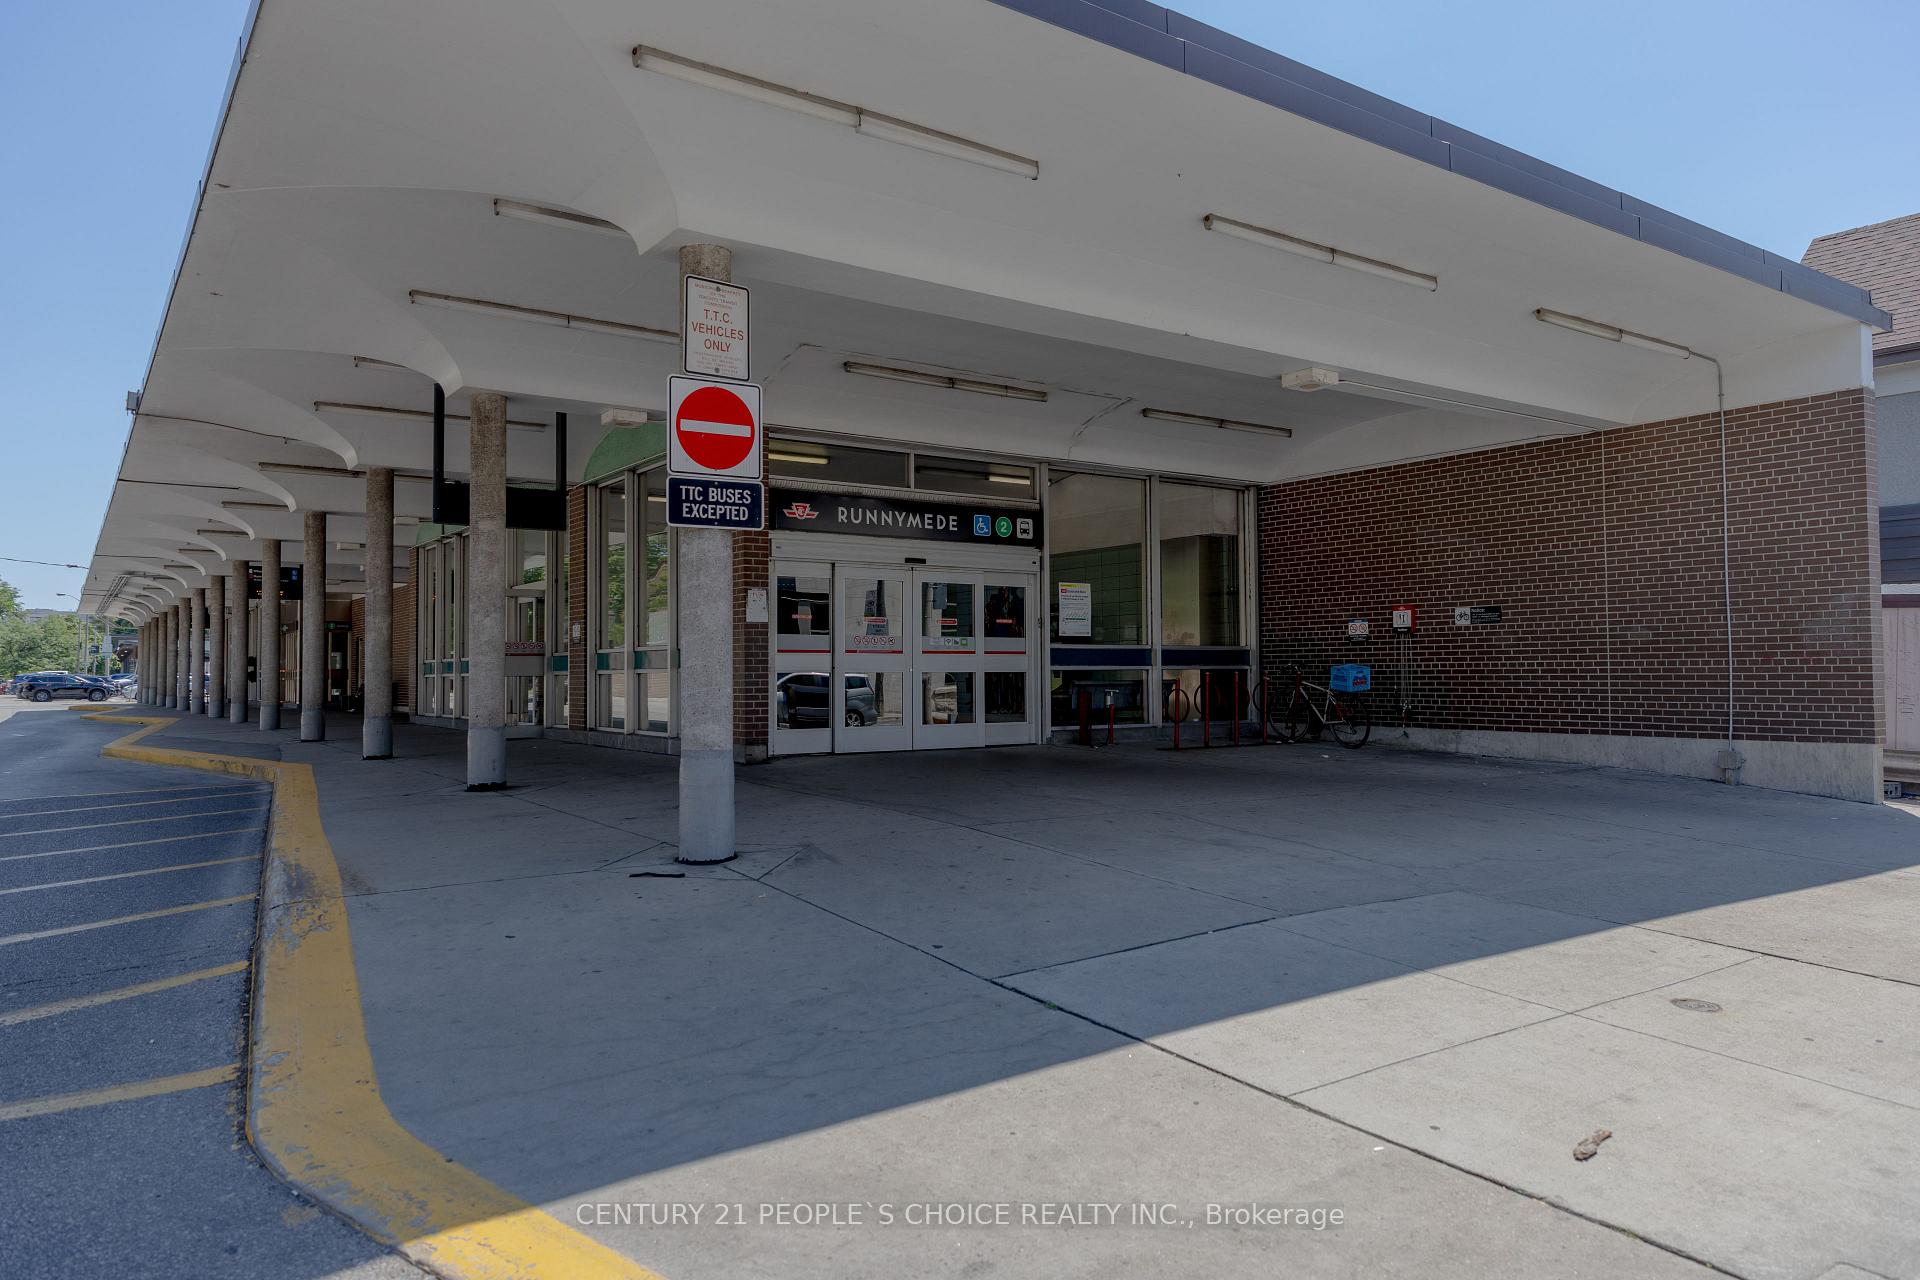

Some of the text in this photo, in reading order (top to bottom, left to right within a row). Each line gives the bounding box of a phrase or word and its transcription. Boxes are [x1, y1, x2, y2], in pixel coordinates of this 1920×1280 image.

[704, 309, 733, 324] T.T.C.
[692, 321, 744, 341] VEHICLES
[704, 339, 731, 352] ONLY
[680, 485, 751, 504] TTC BUSES
[682, 502, 748, 521] EXCEPTED
[838, 506, 958, 531] RUNNYMEDE
[1000, 522, 1007, 533] 2
